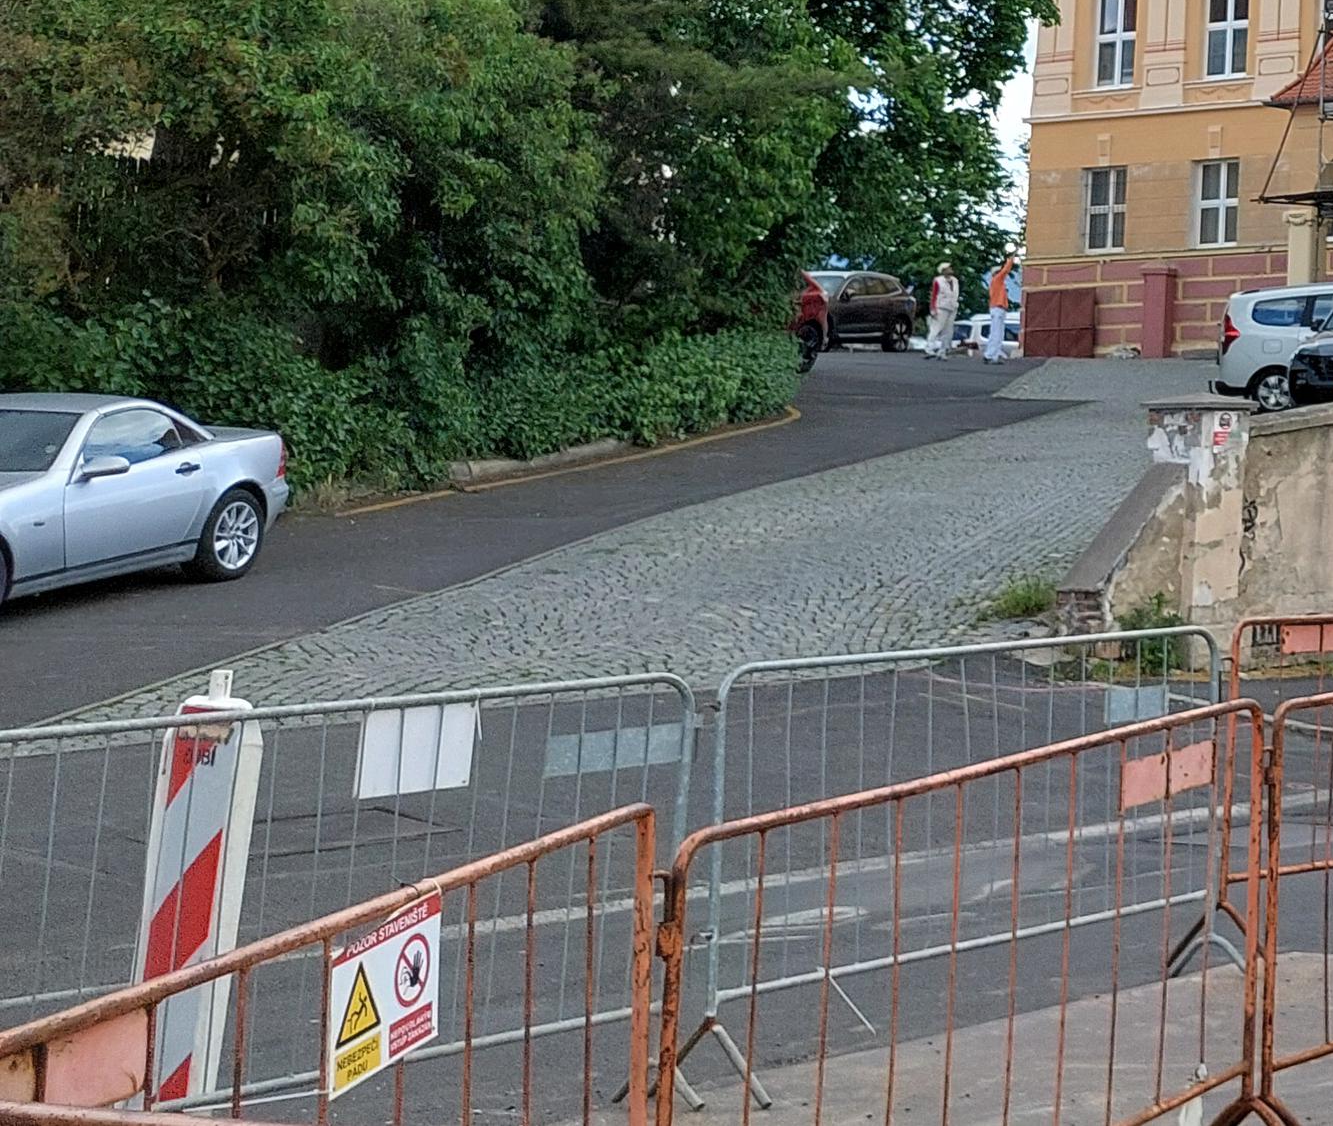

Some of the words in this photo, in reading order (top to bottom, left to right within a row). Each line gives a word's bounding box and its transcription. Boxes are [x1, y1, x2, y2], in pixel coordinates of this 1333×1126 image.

[346, 931, 377, 957] POZOR
[378, 903, 428, 940] STAVENIŠTĚ
[347, 1060, 368, 1081] PÁDU
